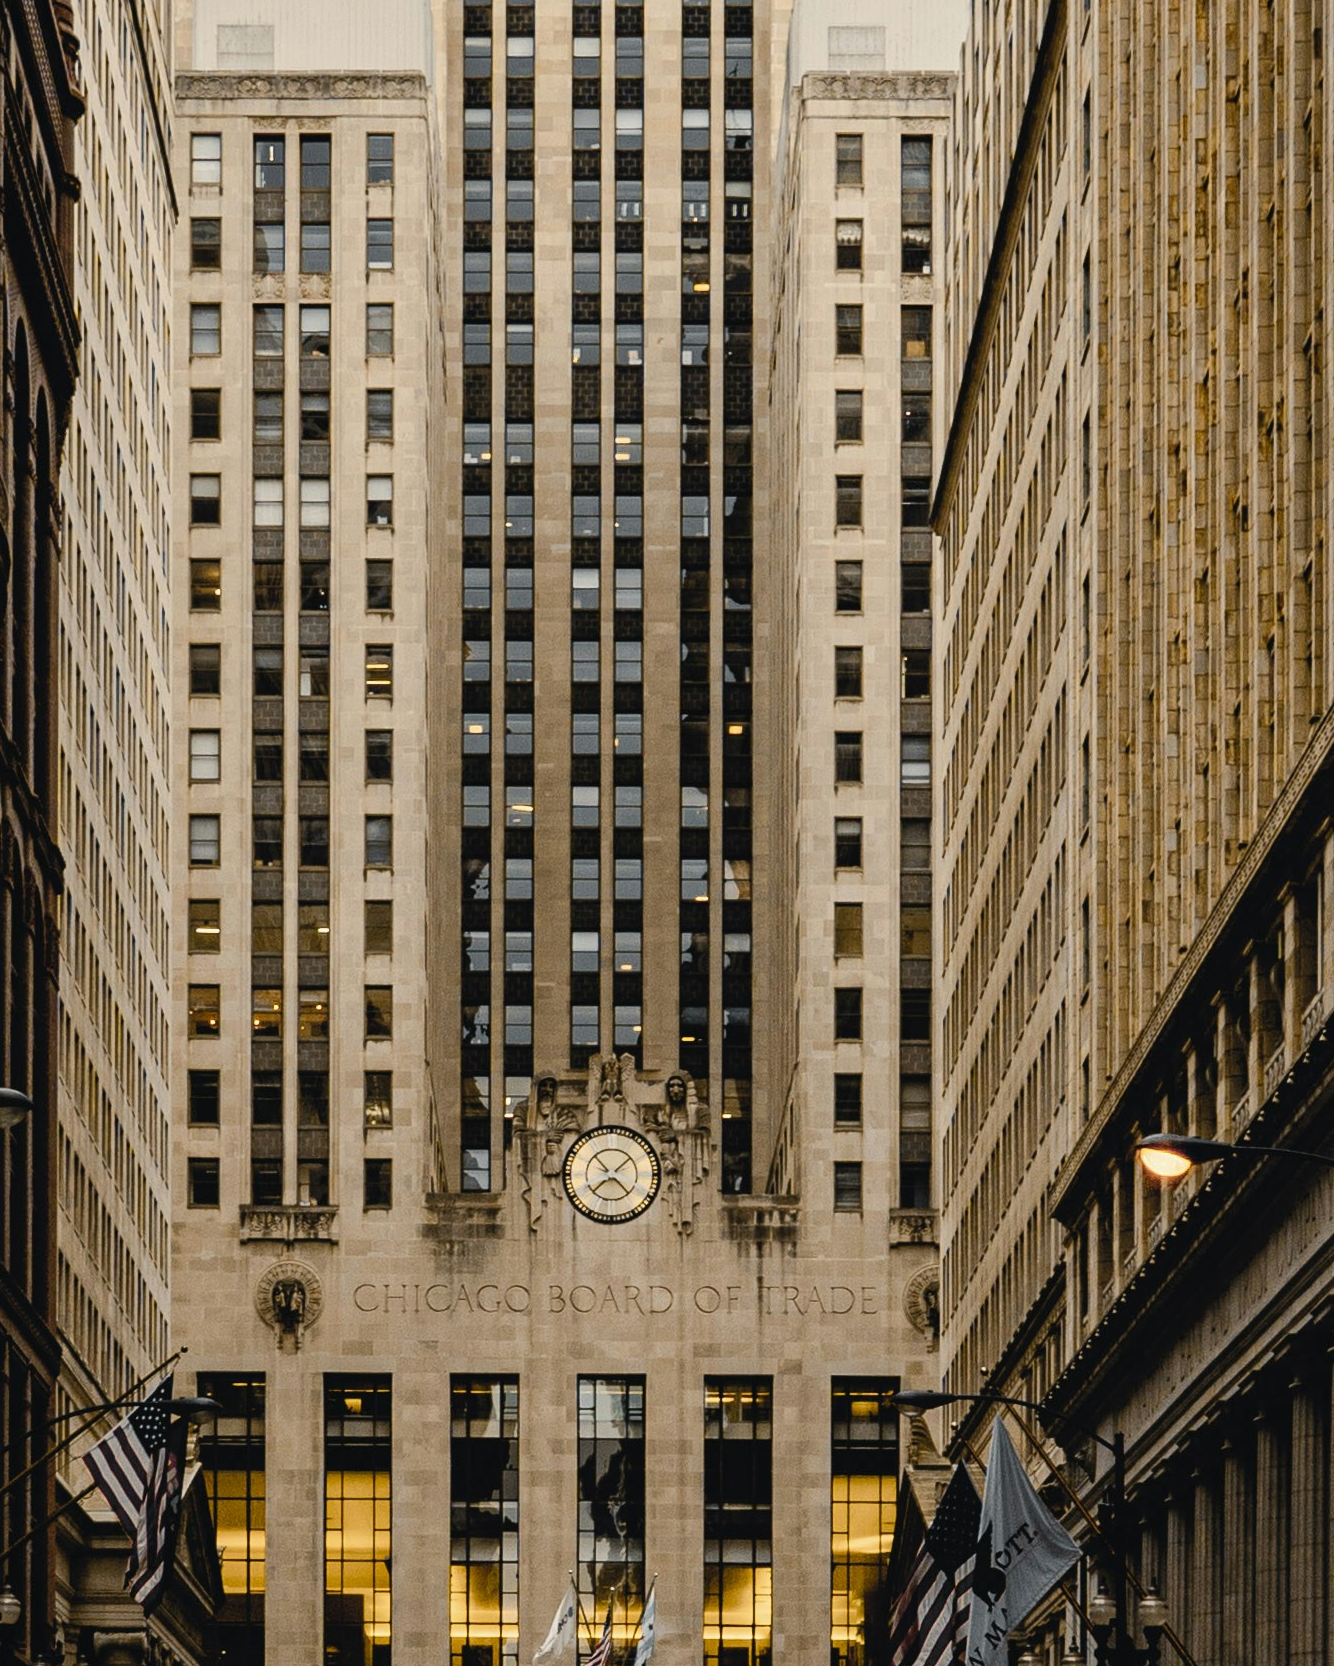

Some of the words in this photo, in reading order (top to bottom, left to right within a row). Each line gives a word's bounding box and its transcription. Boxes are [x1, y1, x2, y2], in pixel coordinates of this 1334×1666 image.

[352, 1283, 530, 1314] CHICAGO
[548, 1284, 675, 1315] BOARD
[694, 1285, 742, 1315] OF
[764, 1285, 879, 1316] TRADE
